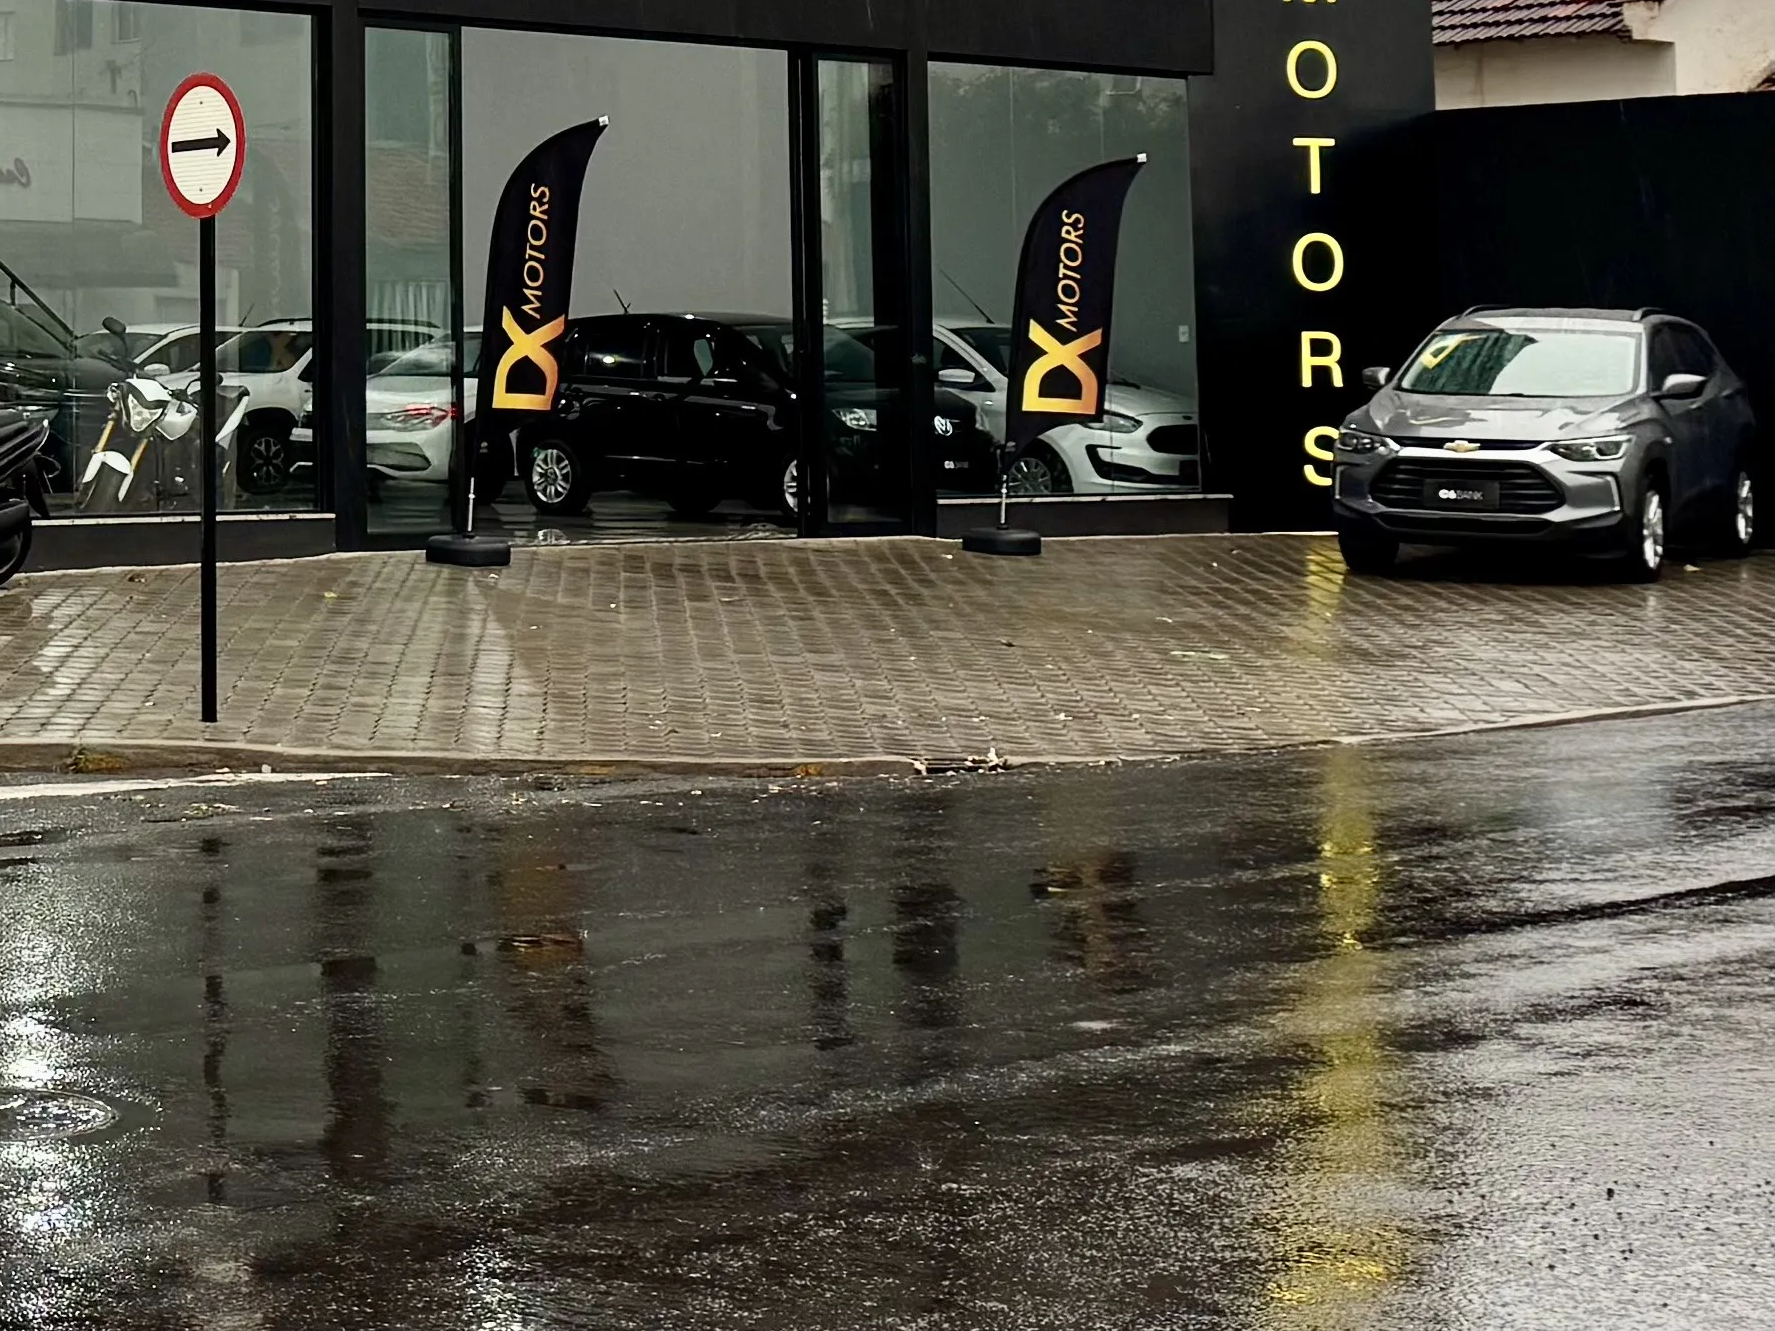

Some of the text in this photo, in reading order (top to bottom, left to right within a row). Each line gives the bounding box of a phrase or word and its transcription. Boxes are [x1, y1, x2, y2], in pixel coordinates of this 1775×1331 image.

[492, 182, 565, 410] DX MOTORS
[1022, 209, 1103, 414] DX MOTORS
